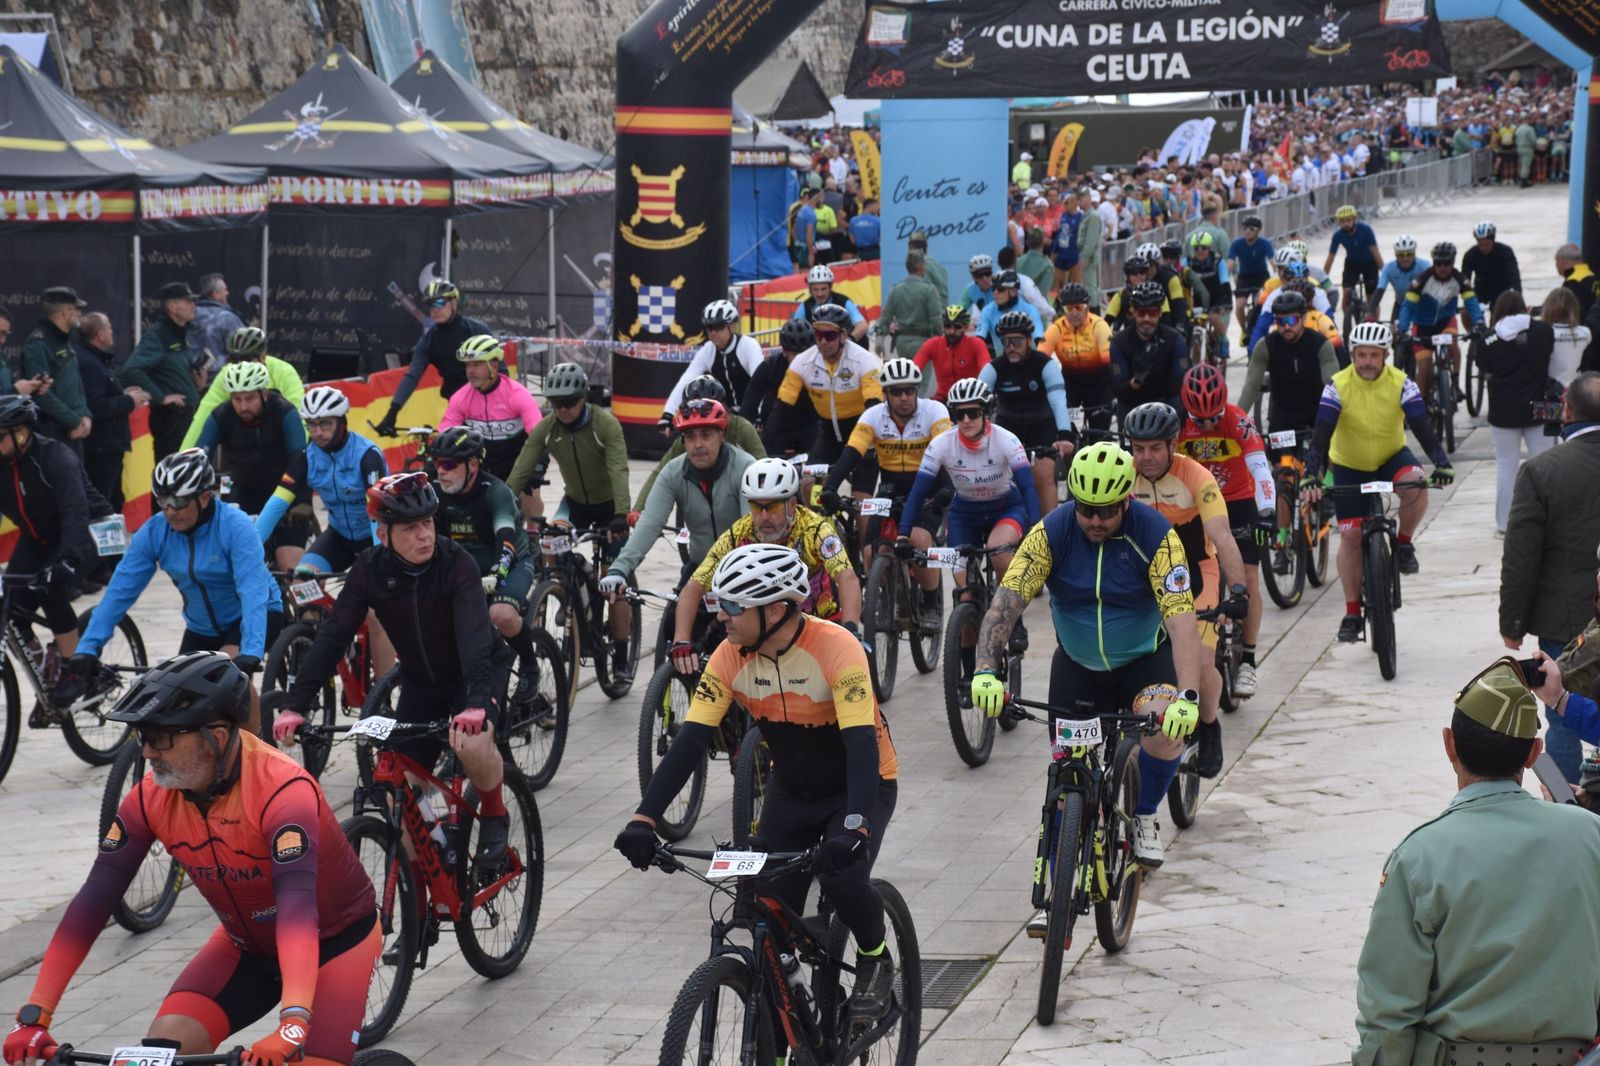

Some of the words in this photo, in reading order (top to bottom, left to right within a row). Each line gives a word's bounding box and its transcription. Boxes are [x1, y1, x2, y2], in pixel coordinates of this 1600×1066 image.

[1059, 0, 1117, 11] CARRERA
[1088, 23, 1118, 46] DE
[1132, 20, 1168, 45] LA
[1086, 52, 1192, 82] CEUTA
[892, 175, 961, 205] Ceuta
[966, 180, 990, 197] es
[0, 190, 102, 221] TIVO
[896, 212, 990, 241] Deporte
[940, 553, 957, 566] 269
[1074, 726, 1098, 739] 470
[736, 860, 755, 871] 68
